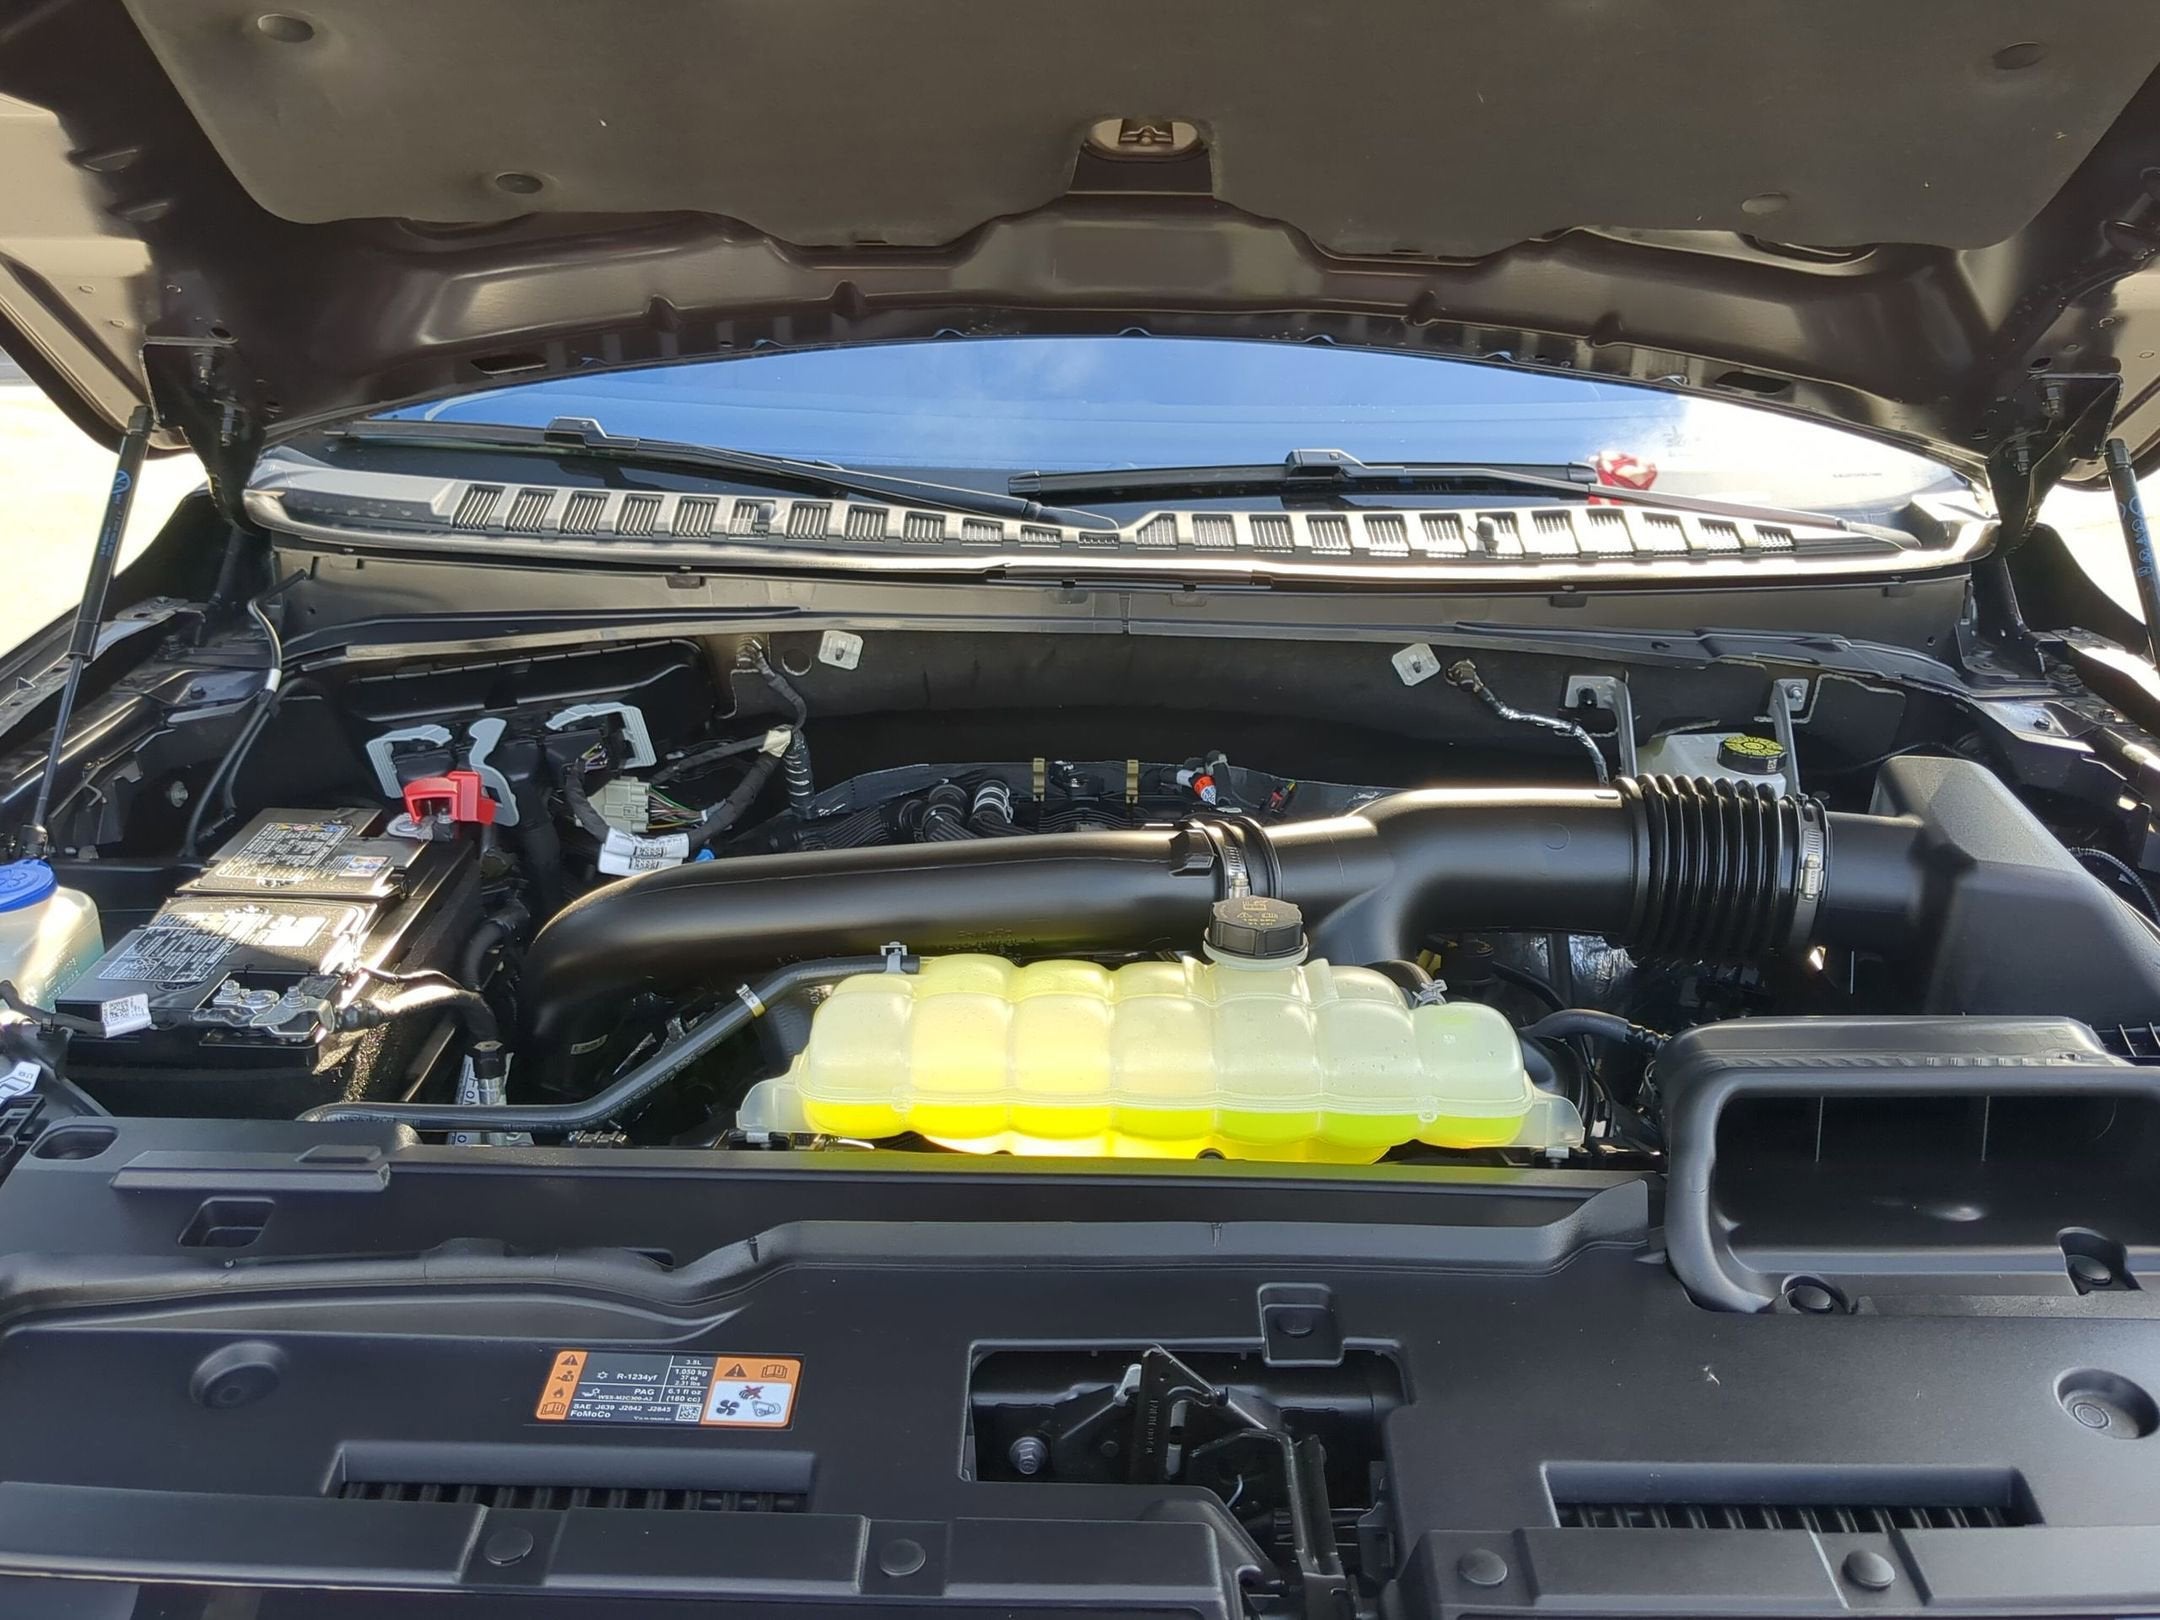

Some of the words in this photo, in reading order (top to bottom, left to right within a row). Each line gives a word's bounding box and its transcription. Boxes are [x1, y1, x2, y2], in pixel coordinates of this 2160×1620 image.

[675, 1368, 696, 1376] 1.050
[698, 1369, 708, 1377] kg
[616, 1373, 658, 1382] R-1234yf
[687, 1396, 701, 1404] cc)
[570, 1410, 611, 1418] FoMoCo
